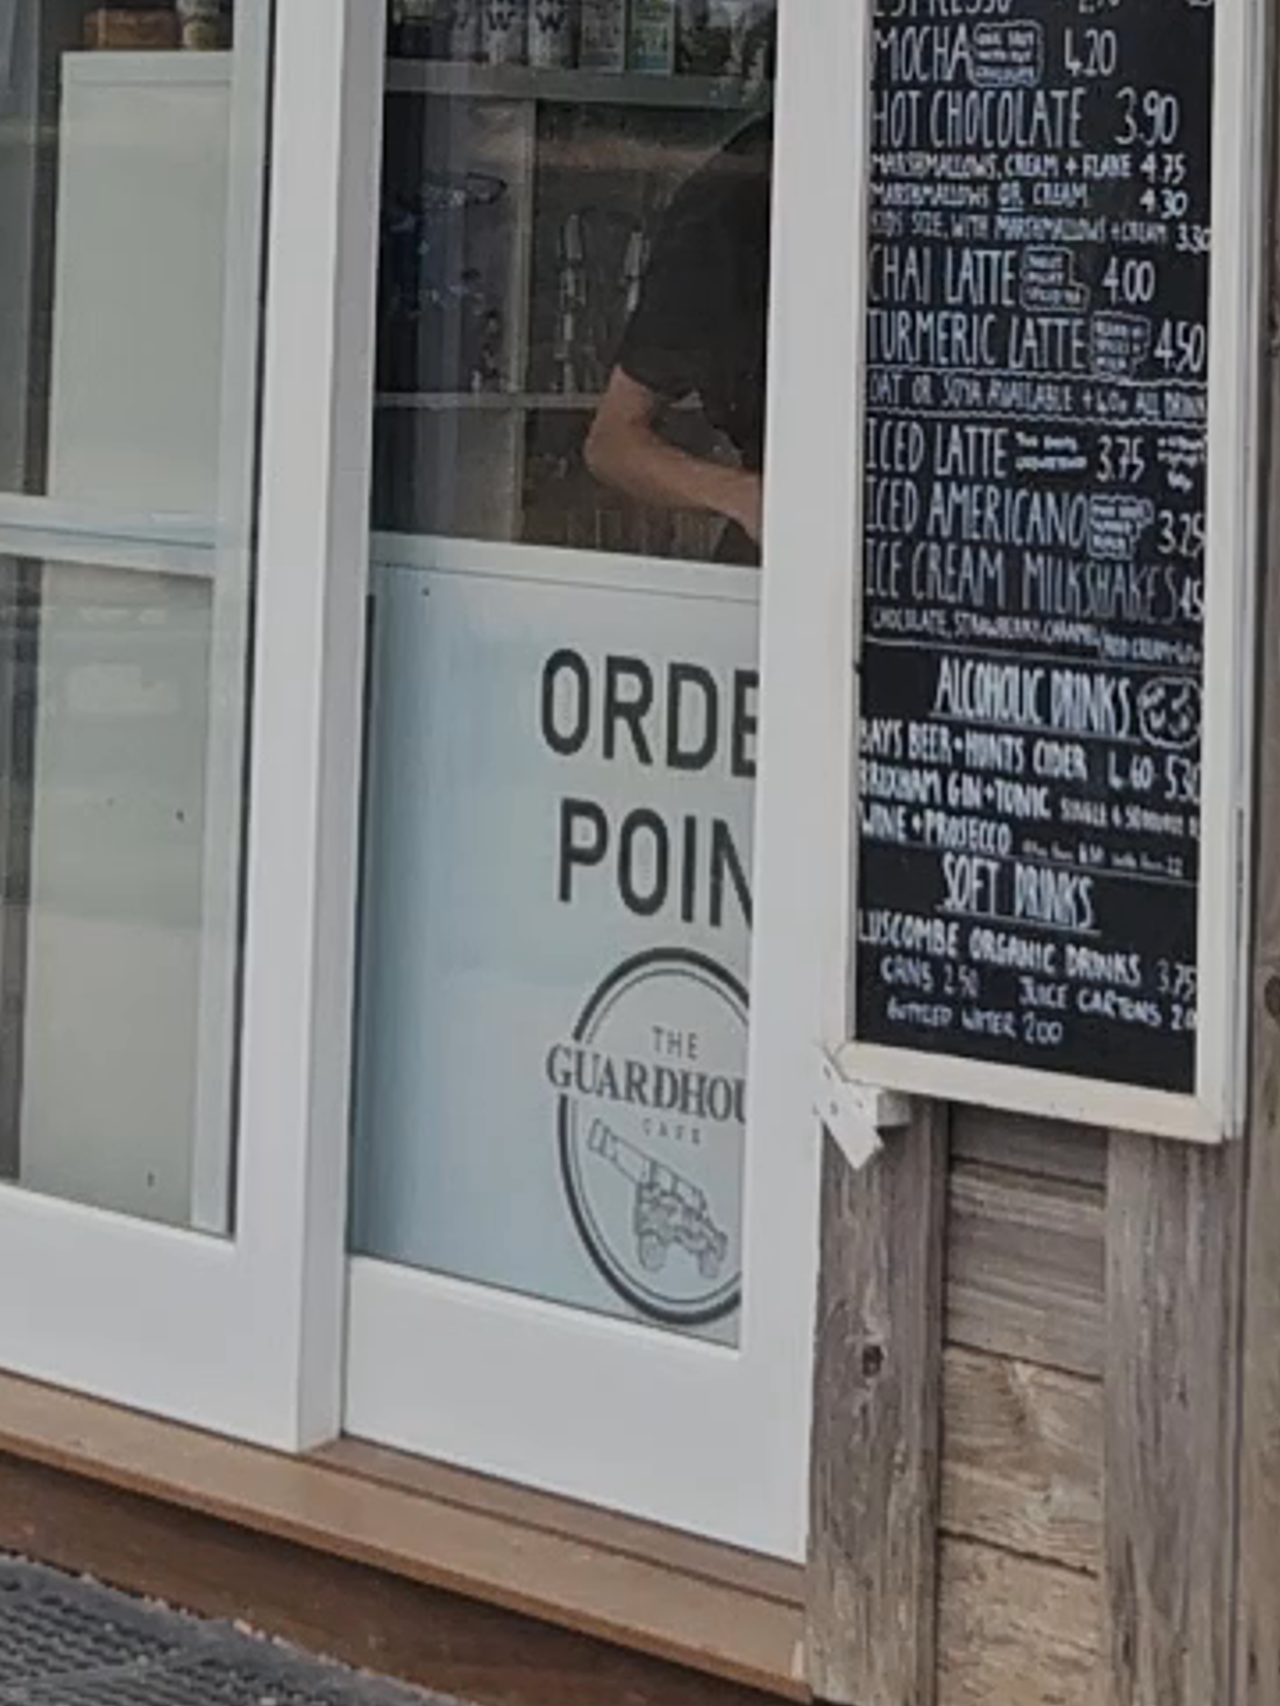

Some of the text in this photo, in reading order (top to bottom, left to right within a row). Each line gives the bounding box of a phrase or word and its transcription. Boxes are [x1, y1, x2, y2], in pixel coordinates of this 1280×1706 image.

[871, 23, 971, 82] MOCHA
[871, 87, 1180, 148] HOT CHOCOLATE 3.90
[869, 245, 1155, 306] CHAI LATTE 4.00
[868, 308, 999, 366] TURMERIC
[1008, 315, 1087, 371] LATTE
[1154, 318, 1206, 373] 4.50
[866, 417, 925, 474] ICED
[934, 423, 1008, 478] LATTE
[1096, 434, 1146, 482] 3.75
[865, 472, 919, 533] ICED
[926, 481, 1089, 550] AMERICANO
[865, 537, 903, 599] ICE
[911, 540, 1005, 609] CREAM
[1022, 550, 1176, 625] MILKSHAKES
[542, 648, 760, 778] ORDE
[934, 656, 1046, 726] ALCOHOLIC
[1051, 669, 1132, 738] DRINKS
[908, 719, 952, 767] BEER
[964, 729, 1025, 773] HUNTS
[1032, 739, 1088, 782] CIDER
[996, 778, 1053, 820] TONIC
[559, 797, 754, 931] POIN
[925, 809, 1012, 857] PROSECCO
[941, 851, 1095, 930] SOFT DRINKS
[857, 907, 960, 958] LUSCOMBE
[969, 927, 1055, 974] ORGANIC
[1065, 942, 1141, 987] DRINKS
[880, 954, 934, 992] CANS
[1019, 976, 1069, 1010] JUICE
[1077, 986, 1163, 1028] CARTONS
[652, 1025, 699, 1062] THE
